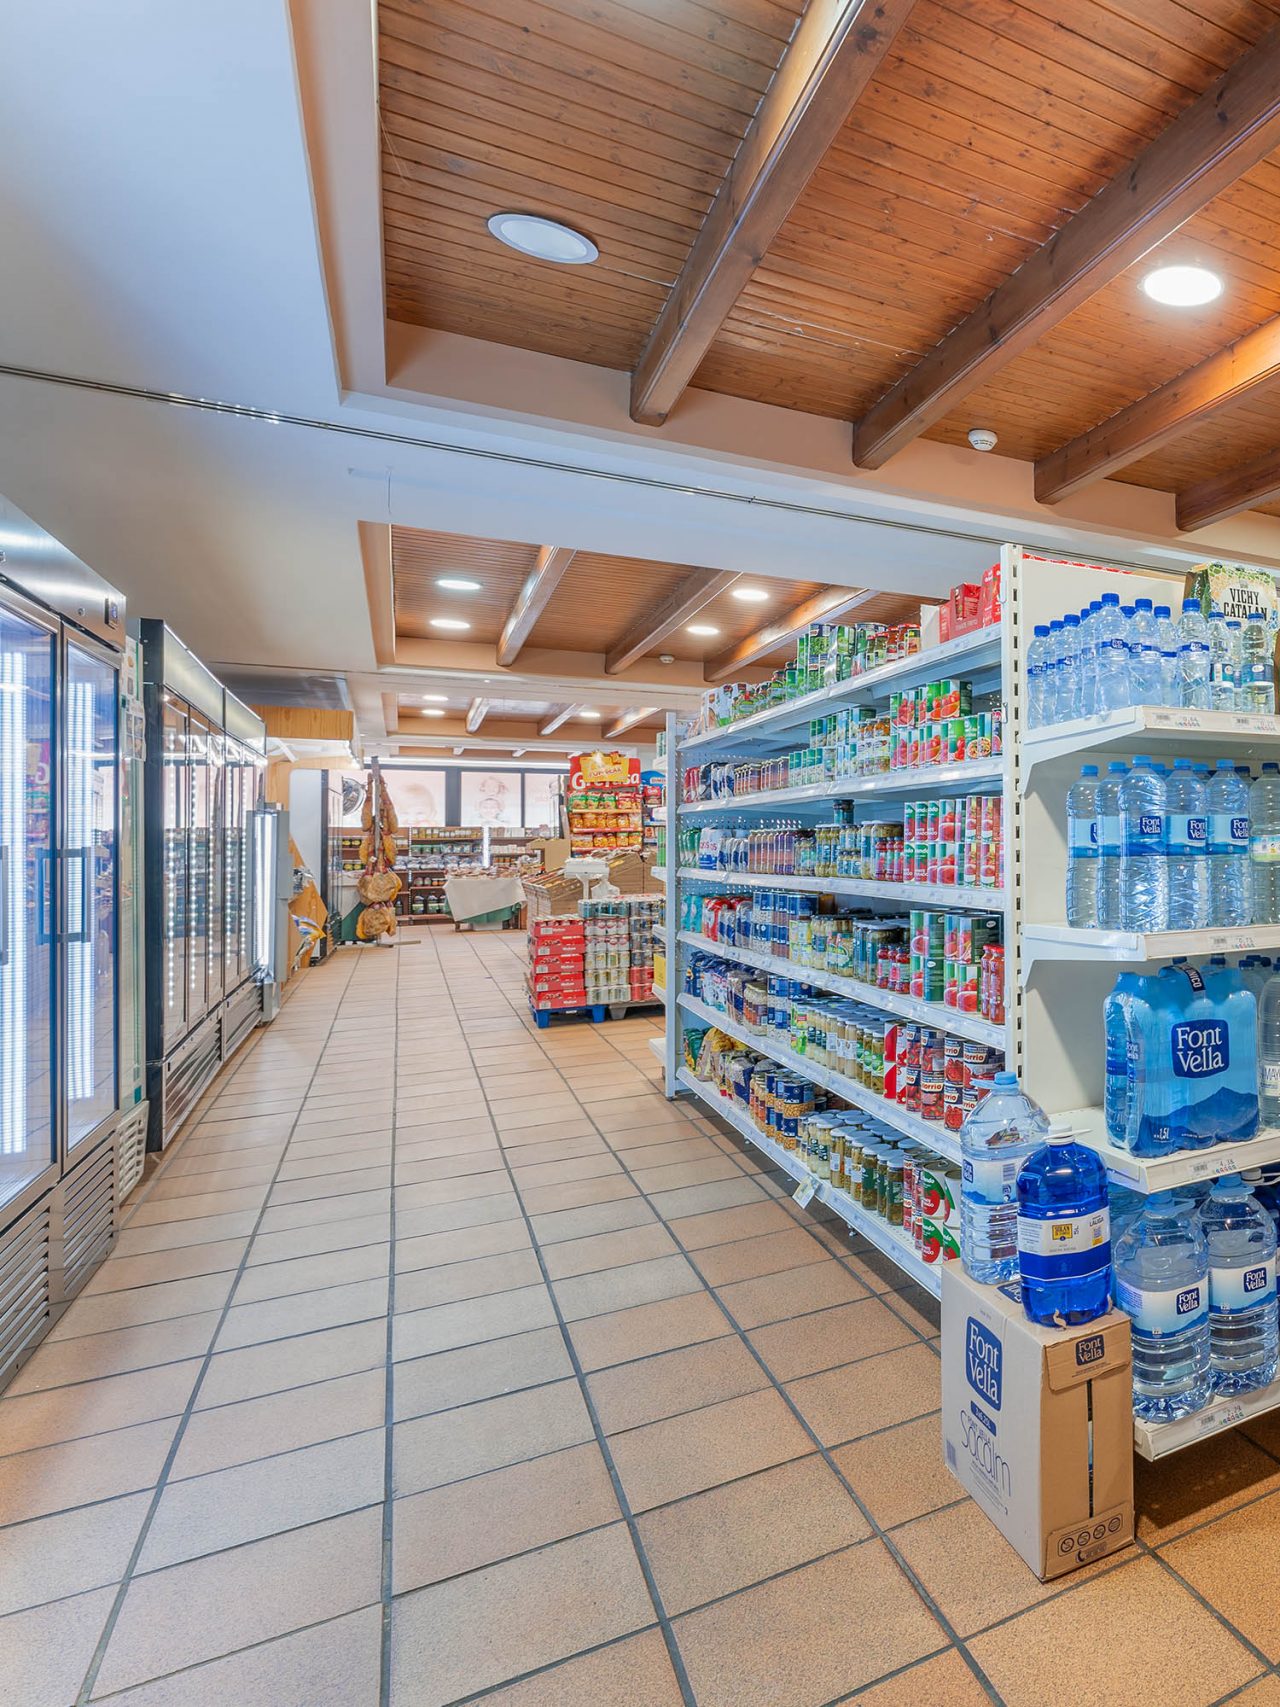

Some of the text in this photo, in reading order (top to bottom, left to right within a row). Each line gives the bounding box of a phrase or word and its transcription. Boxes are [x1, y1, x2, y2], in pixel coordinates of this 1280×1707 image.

[1229, 587, 1259, 605] VICHY
[1142, 817, 1160, 826] Font
[1142, 824, 1161, 834] Vella
[1233, 819, 1248, 829] Fon
[1176, 1026, 1223, 1049] Font
[1177, 1048, 1224, 1073] Vella
[1246, 1271, 1265, 1282] Font
[1246, 1279, 1266, 1291] Vella
[1178, 1289, 1198, 1302] Font
[1178, 1299, 1199, 1313] Vella
[970, 1322, 999, 1373] Font
[1078, 1337, 1102, 1353] Font
[1079, 1347, 1103, 1363] Vella
[968, 1352, 999, 1404] Vella
